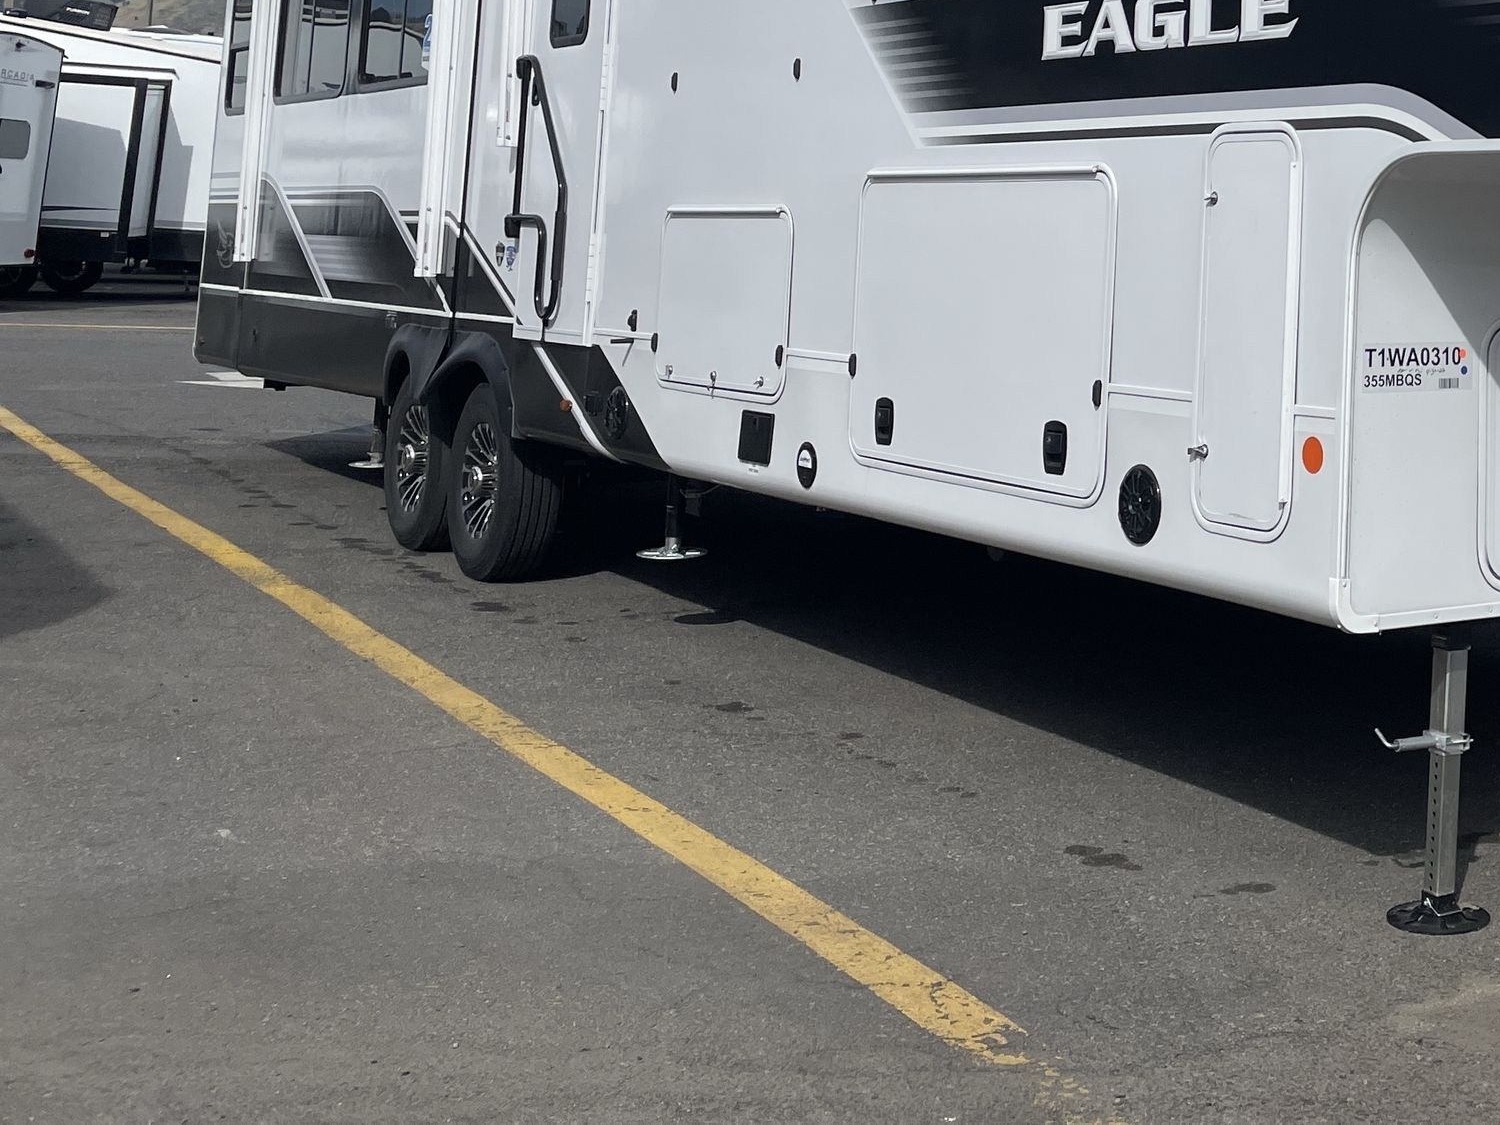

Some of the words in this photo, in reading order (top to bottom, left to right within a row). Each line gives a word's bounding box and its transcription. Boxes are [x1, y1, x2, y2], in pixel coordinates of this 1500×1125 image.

[0, 68, 35, 81] RCADIA
[1365, 346, 1461, 367] T1WA0310
[1364, 374, 1422, 387] 355MBQS
